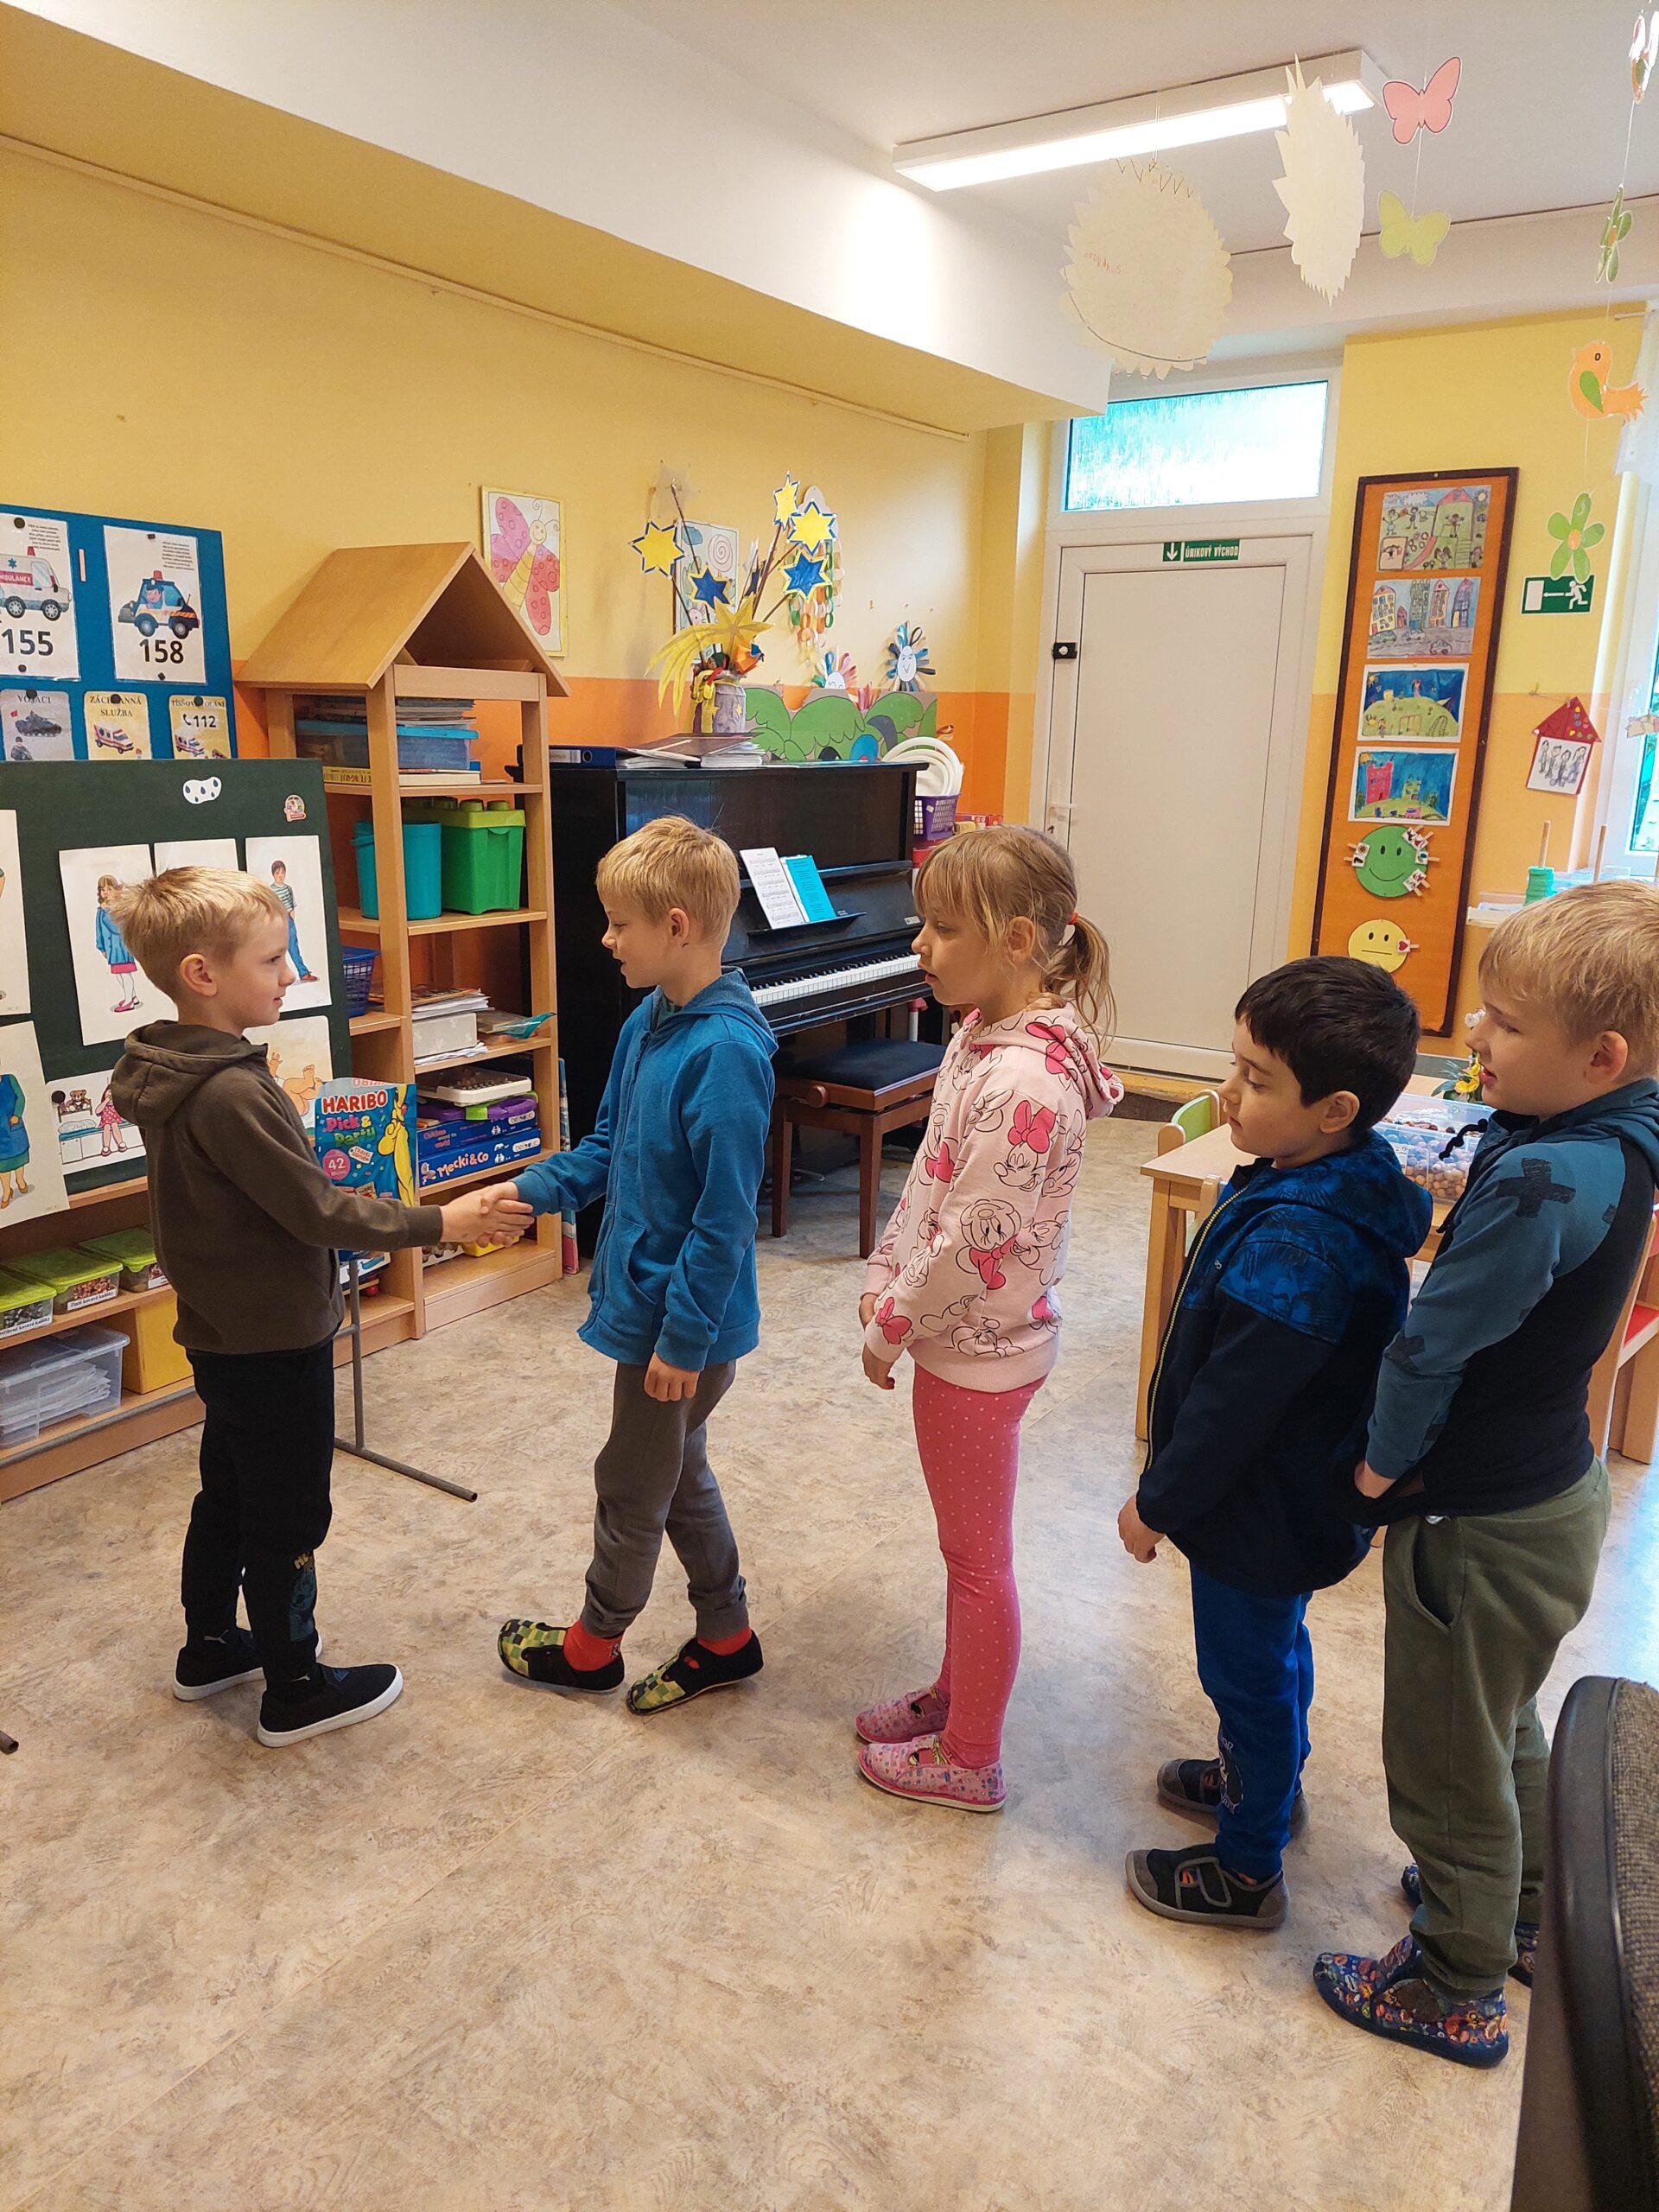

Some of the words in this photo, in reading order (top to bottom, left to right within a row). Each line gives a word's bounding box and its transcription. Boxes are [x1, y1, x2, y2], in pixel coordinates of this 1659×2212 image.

[1185, 545, 1211, 557] ÚNIKOVÝ
[1214, 544, 1238, 556] VÝCHOD
[0, 573, 32, 583] MBULANCE
[1, 628, 54, 657] 155
[139, 639, 184, 664] 158
[100, 708, 133, 717] SLUŽBA
[193, 715, 217, 728] 112
[321, 1090, 388, 1115] HARIBO
[325, 1115, 360, 1133] Pick
[361, 1116, 372, 1128] &
[334, 1128, 376, 1147] Party
[328, 1157, 346, 1170] 42
